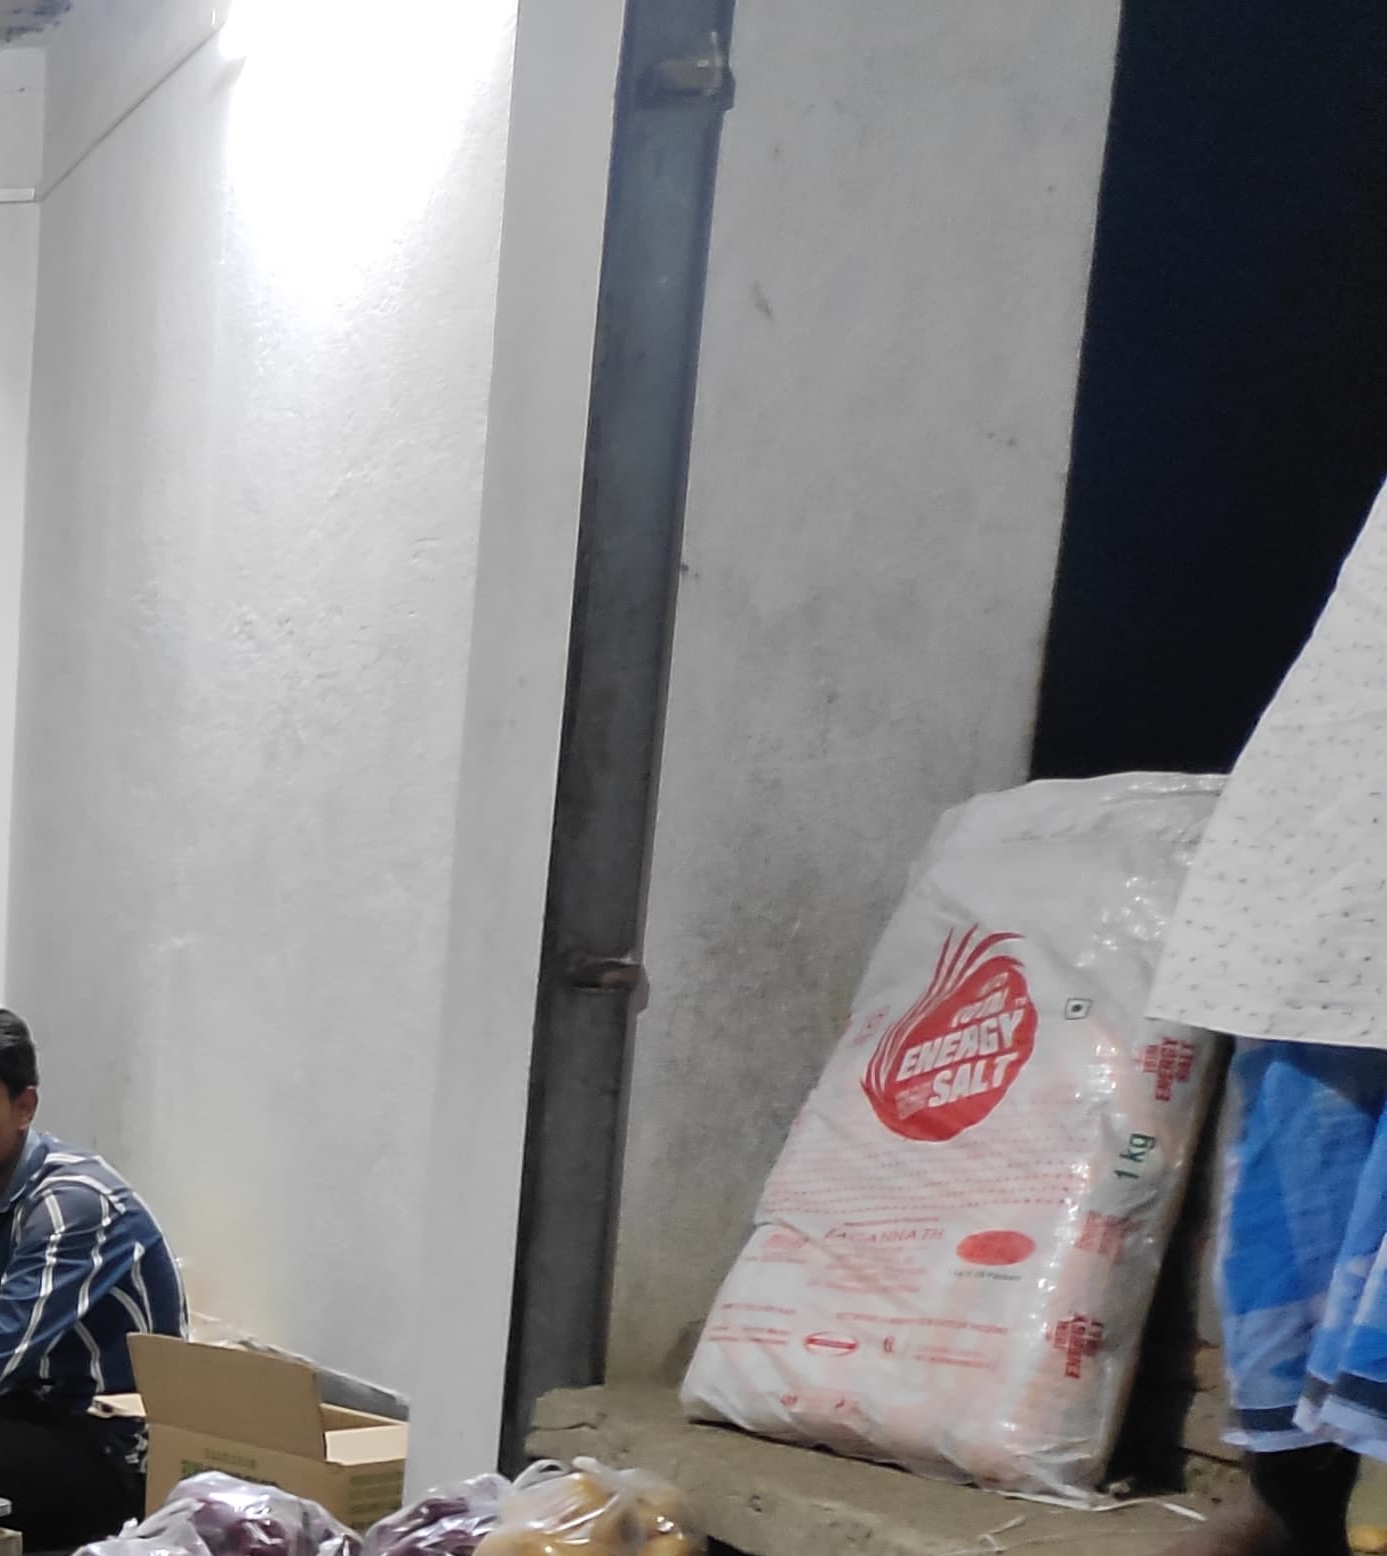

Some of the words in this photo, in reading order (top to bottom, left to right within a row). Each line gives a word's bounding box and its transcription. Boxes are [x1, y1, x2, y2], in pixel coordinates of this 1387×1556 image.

[895, 1007, 1025, 1082] ENERGY
[928, 1051, 1020, 1108] SALT
[1119, 1132, 1157, 1164] kg
